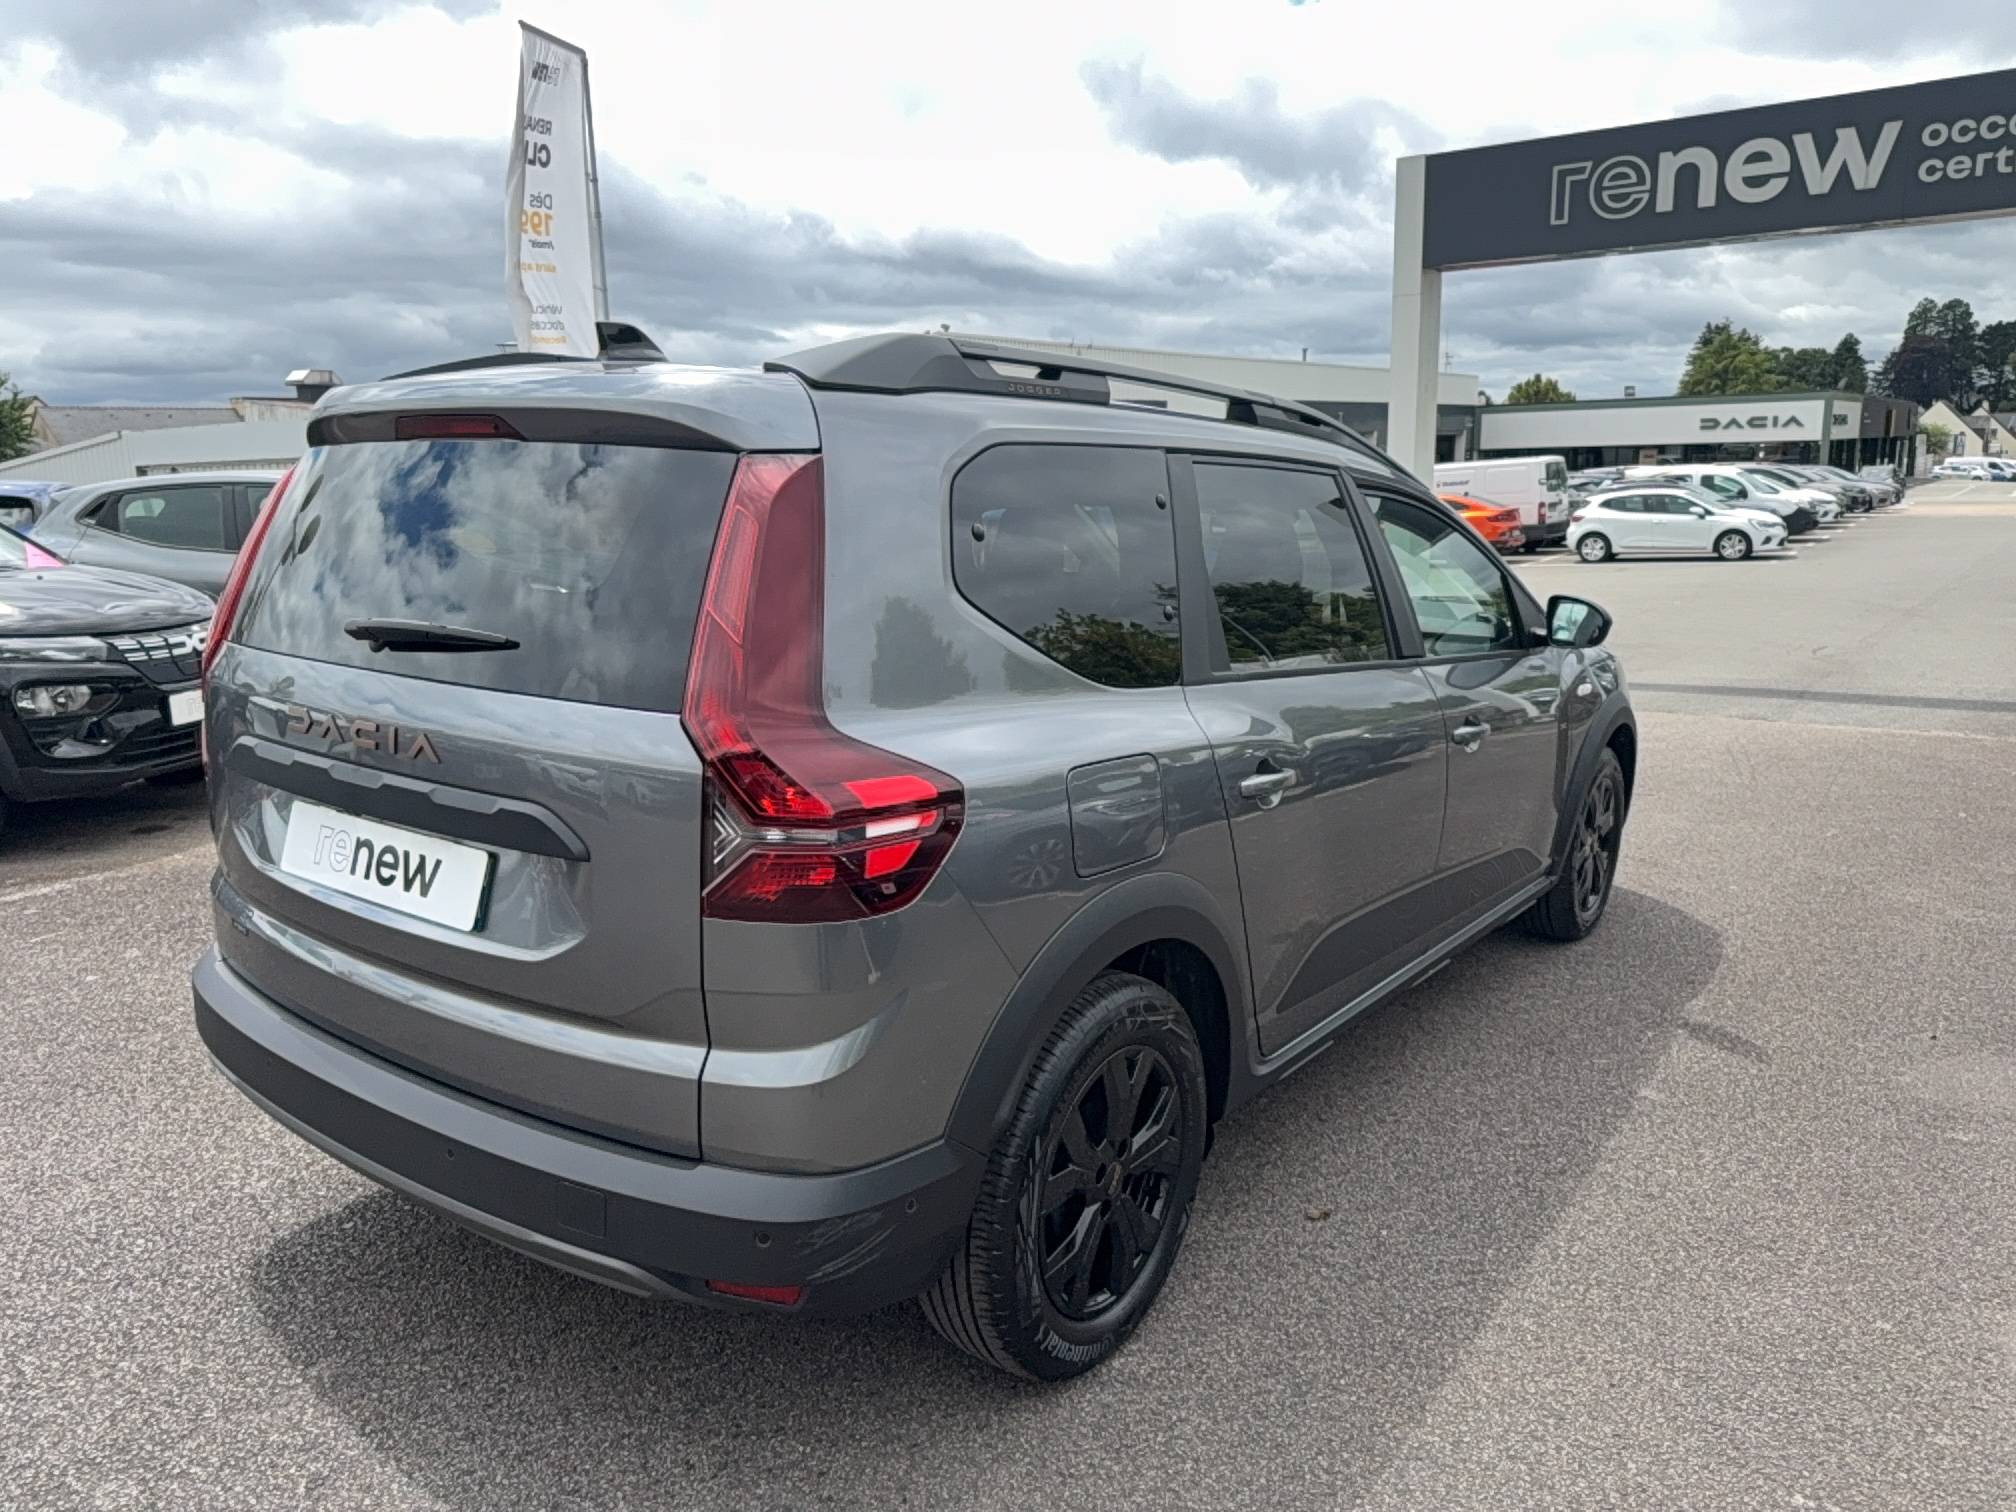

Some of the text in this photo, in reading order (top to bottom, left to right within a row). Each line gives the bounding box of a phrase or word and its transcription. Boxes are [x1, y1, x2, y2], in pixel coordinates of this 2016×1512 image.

[1921, 113, 2016, 147] occ
[1550, 120, 1904, 225] renew
[1918, 145, 2016, 183] cert
[1699, 415, 1805, 431] DACIA
[286, 706, 442, 764] DACIA
[313, 824, 443, 899] renew
